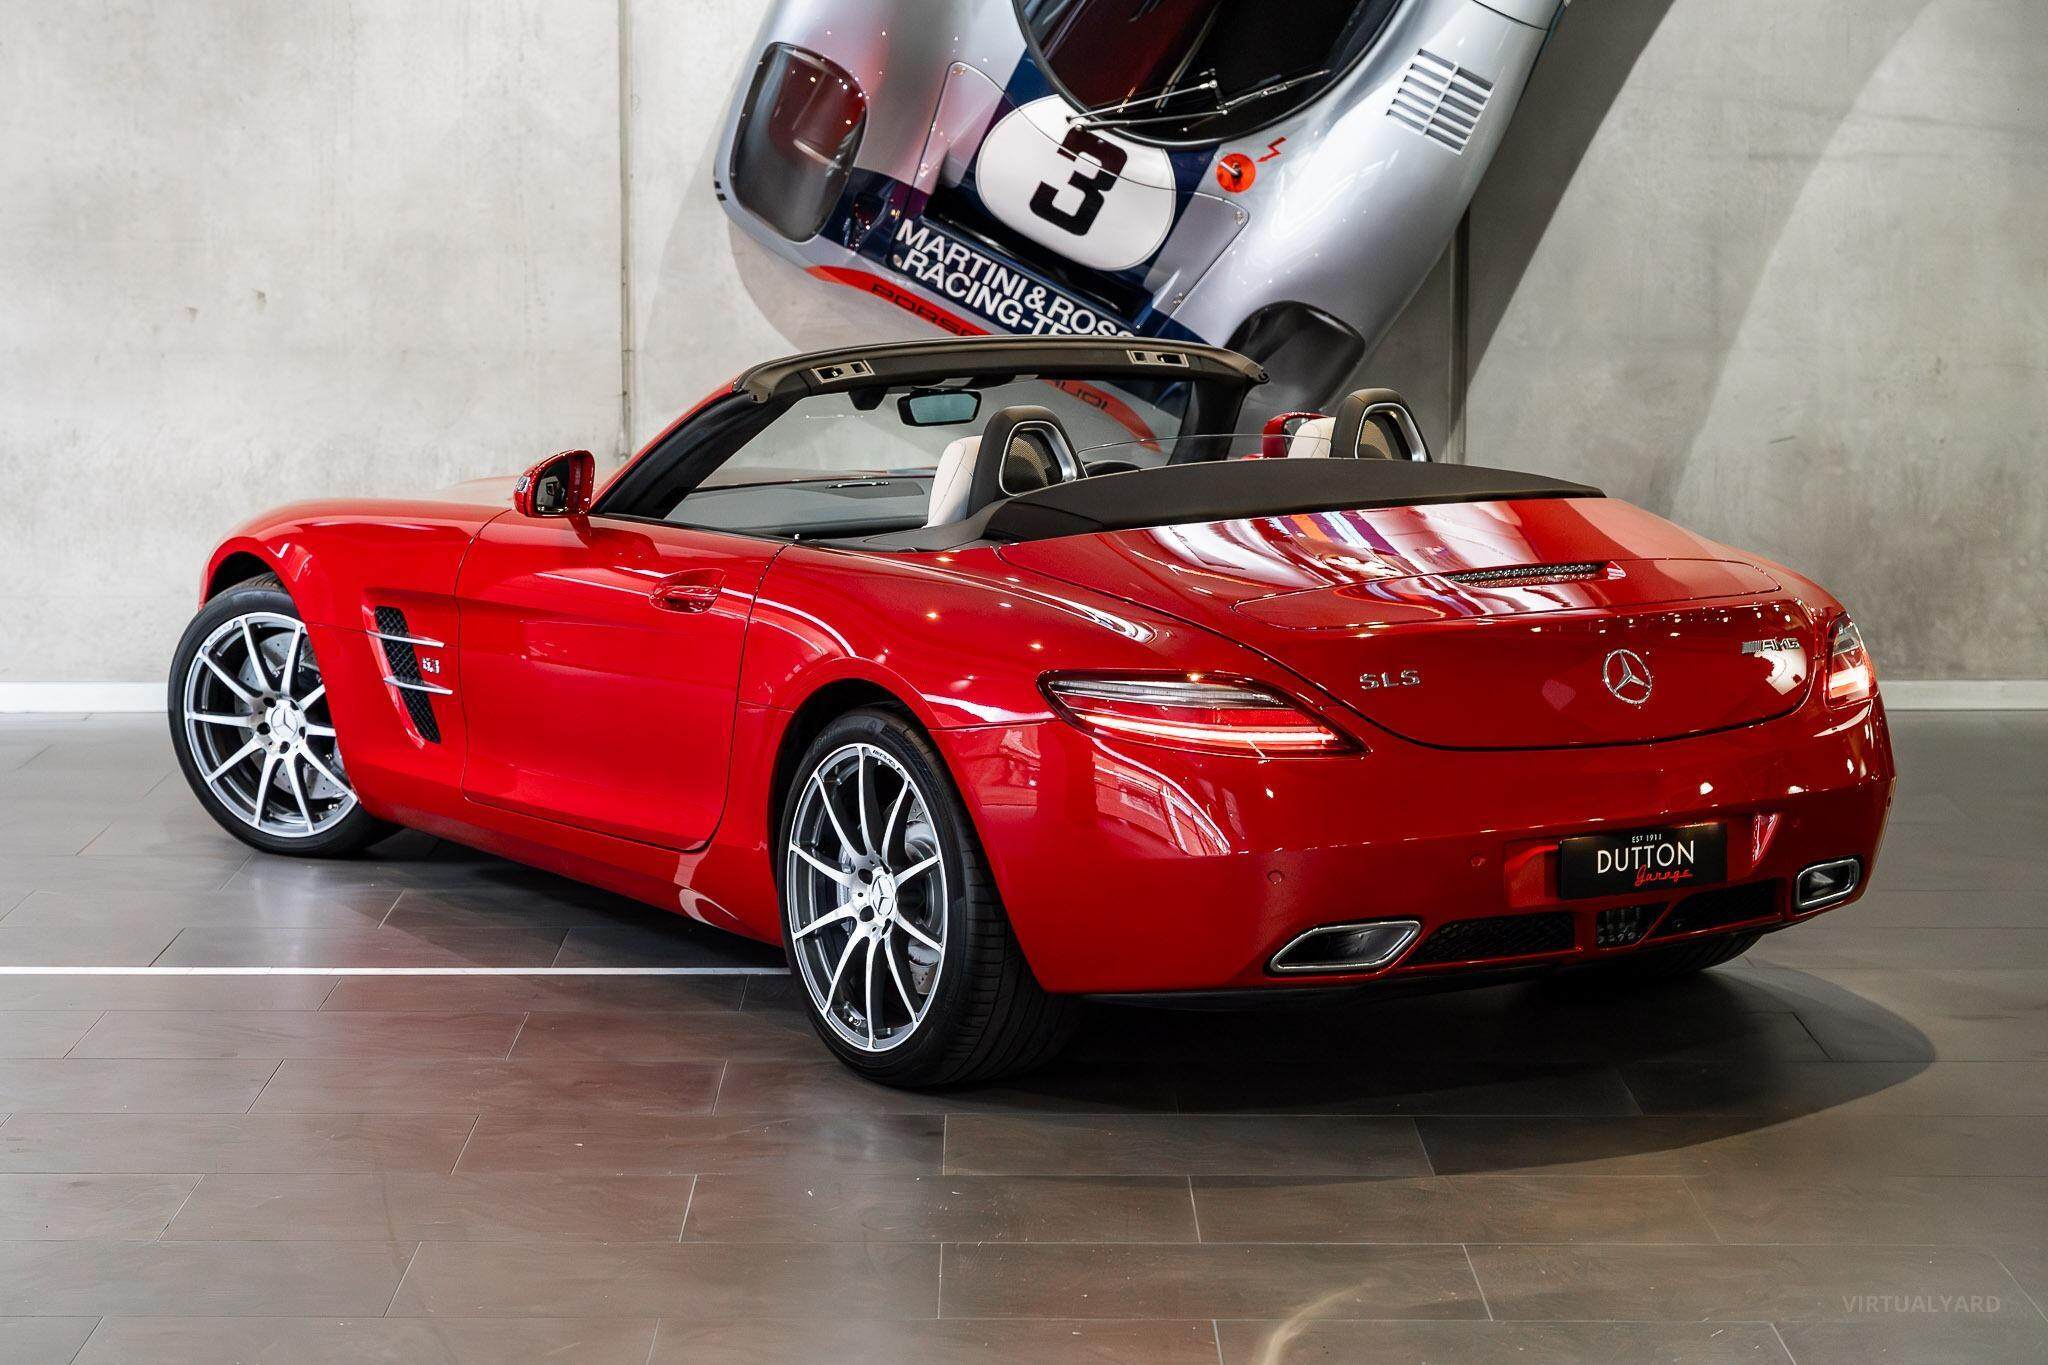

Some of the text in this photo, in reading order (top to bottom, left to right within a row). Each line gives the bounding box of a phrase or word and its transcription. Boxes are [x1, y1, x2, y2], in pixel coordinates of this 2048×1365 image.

[1029, 124, 1128, 236] 3
[896, 218, 1029, 300] MARTINI
[1023, 285, 1046, 313] &
[1762, 637, 1800, 651] AMG
[1359, 669, 1420, 690] SLS
[1631, 835, 1643, 844] EST
[1597, 840, 1694, 874] DUTTON
[1634, 863, 1694, 887] Garage
